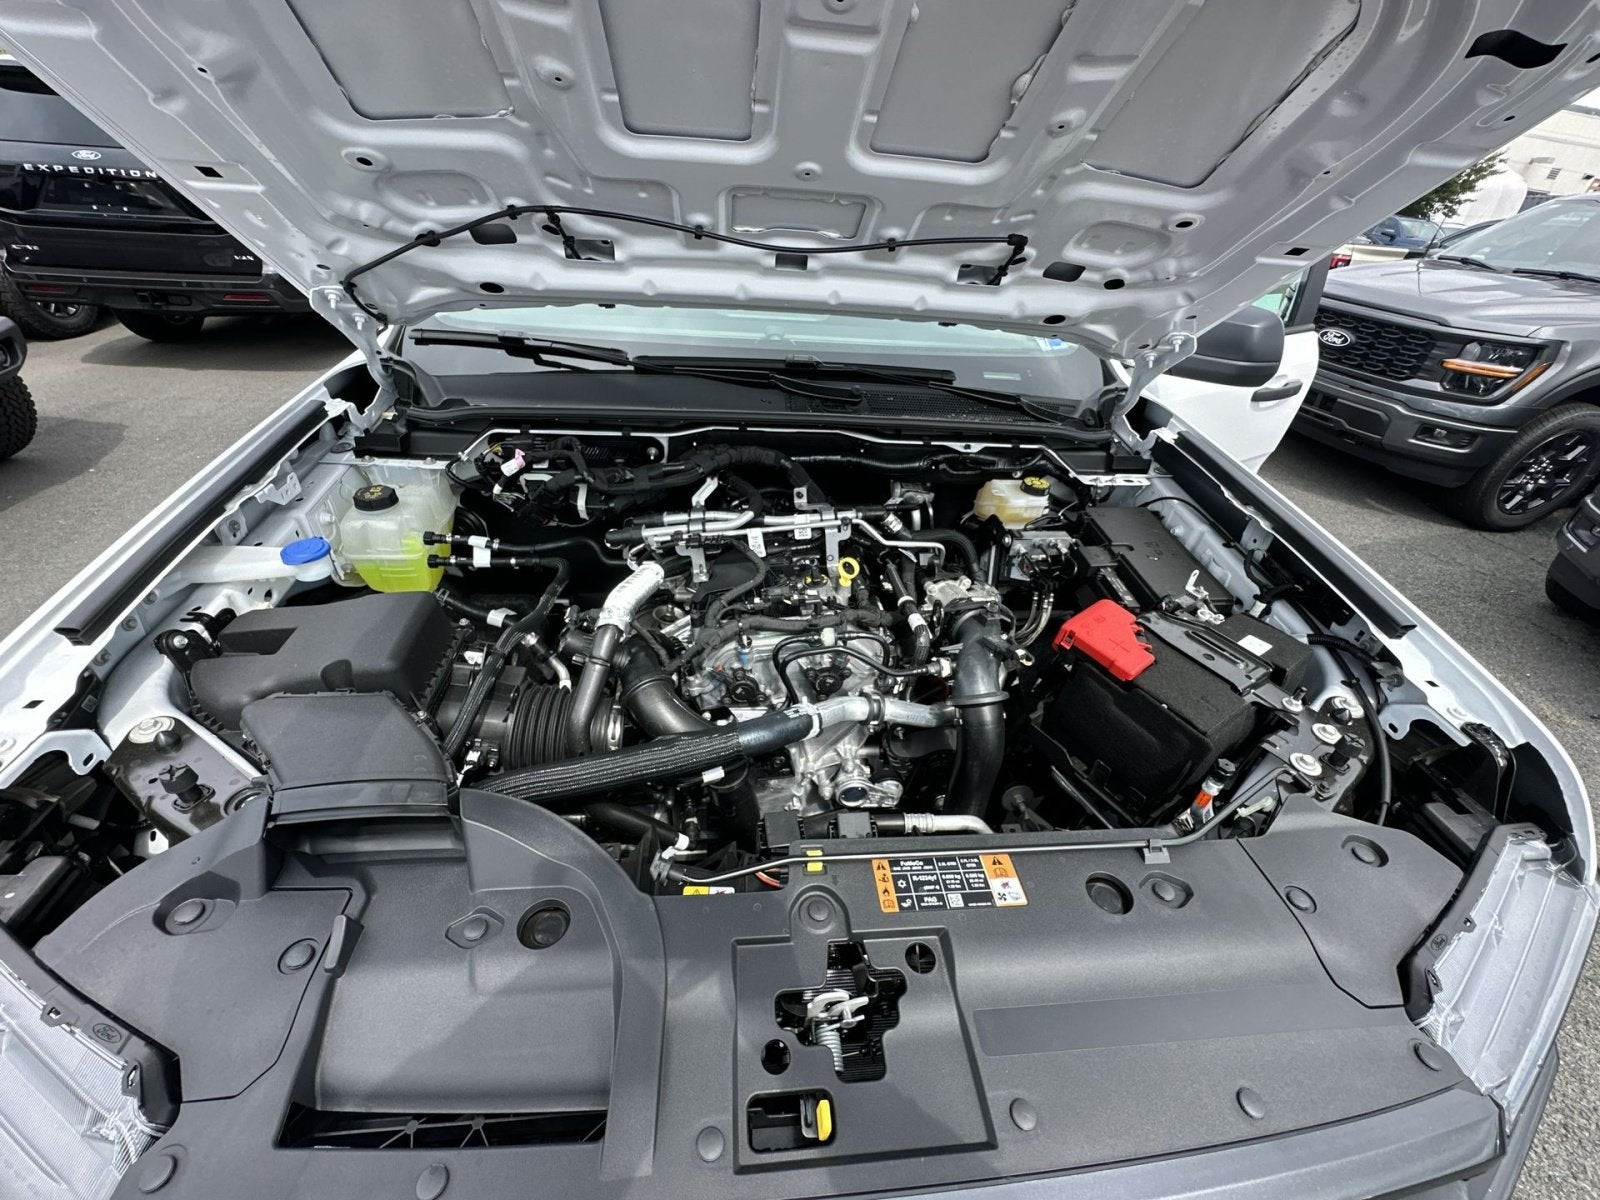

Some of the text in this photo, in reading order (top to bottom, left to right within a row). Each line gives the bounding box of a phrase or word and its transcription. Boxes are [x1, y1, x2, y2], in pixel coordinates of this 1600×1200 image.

[23, 163, 157, 178] EXPEDITION
[1322, 331, 1346, 346] Ford
[95, 1024, 119, 1041] Ford
